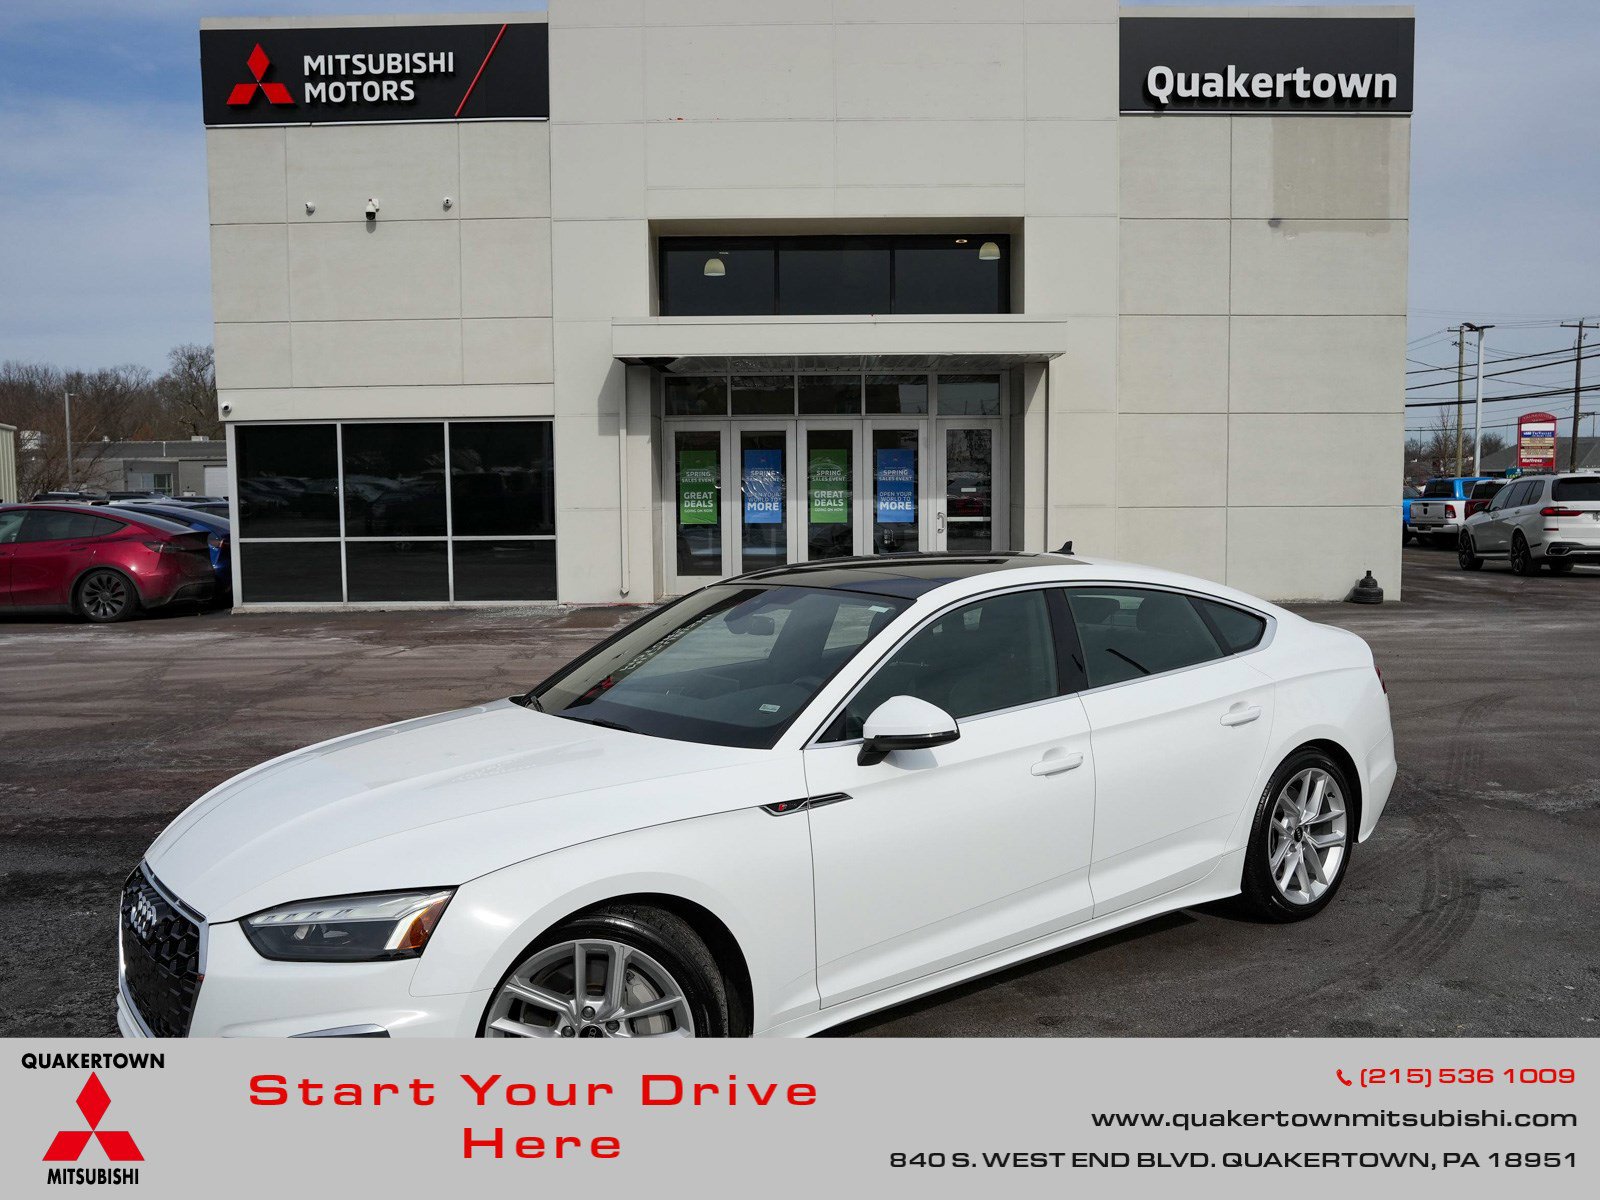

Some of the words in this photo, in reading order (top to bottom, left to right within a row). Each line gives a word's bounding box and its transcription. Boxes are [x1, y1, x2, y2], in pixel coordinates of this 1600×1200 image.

[304, 52, 453, 75] MITSUBISHI
[305, 80, 414, 102] MOTORS
[1148, 65, 1396, 103] Quakertown
[747, 502, 779, 511] MORE
[880, 502, 911, 510] MORE
